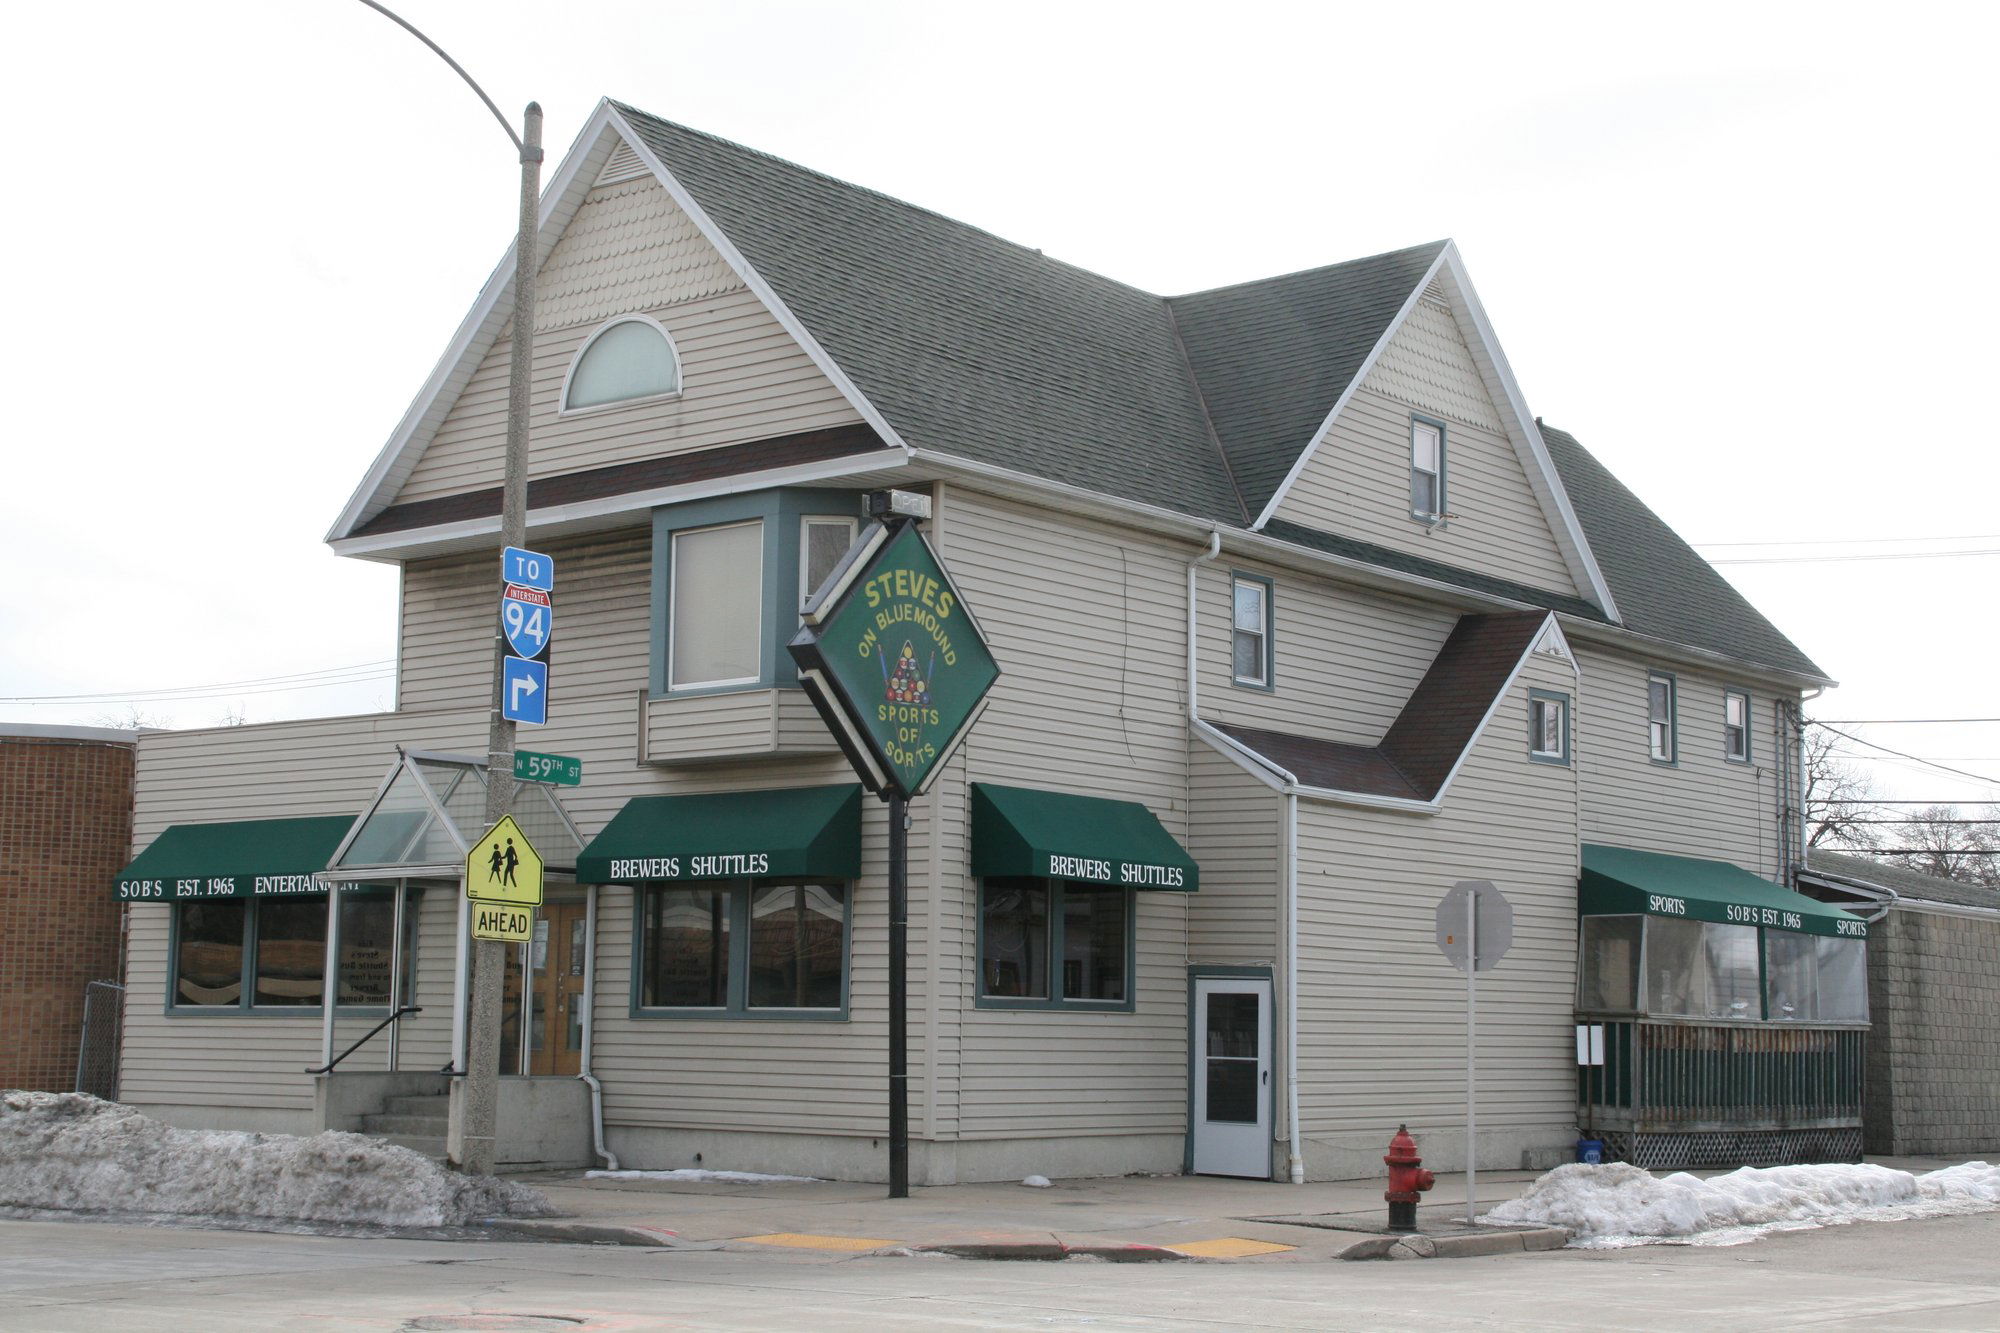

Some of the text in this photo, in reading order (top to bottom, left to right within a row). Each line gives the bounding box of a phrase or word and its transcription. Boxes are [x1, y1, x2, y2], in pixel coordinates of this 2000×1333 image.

[516, 557, 540, 580] TO
[510, 587, 545, 604] INTERSTATE
[864, 569, 954, 619] STEVES
[506, 602, 544, 646] 94
[858, 603, 957, 667] ON BLUEMOUND
[878, 704, 939, 725] SPORTS
[899, 729, 919, 743] OF
[885, 742, 935, 768] SORTS
[516, 757, 580, 778] N 59TH ST
[610, 853, 769, 879] BREWERS SHUTTLES
[1050, 855, 1183, 887] BREWERS SHUTTLES
[176, 879, 203, 897] EST.
[207, 877, 235, 895] 1965
[254, 874, 359, 894] ENTERTAIN
[1649, 894, 1685, 915] SPORTS
[478, 911, 528, 934] AHEAD
[1762, 910, 1781, 926] EST.
[1782, 912, 1801, 929] 1965
[1836, 919, 1867, 936] SPORTS
